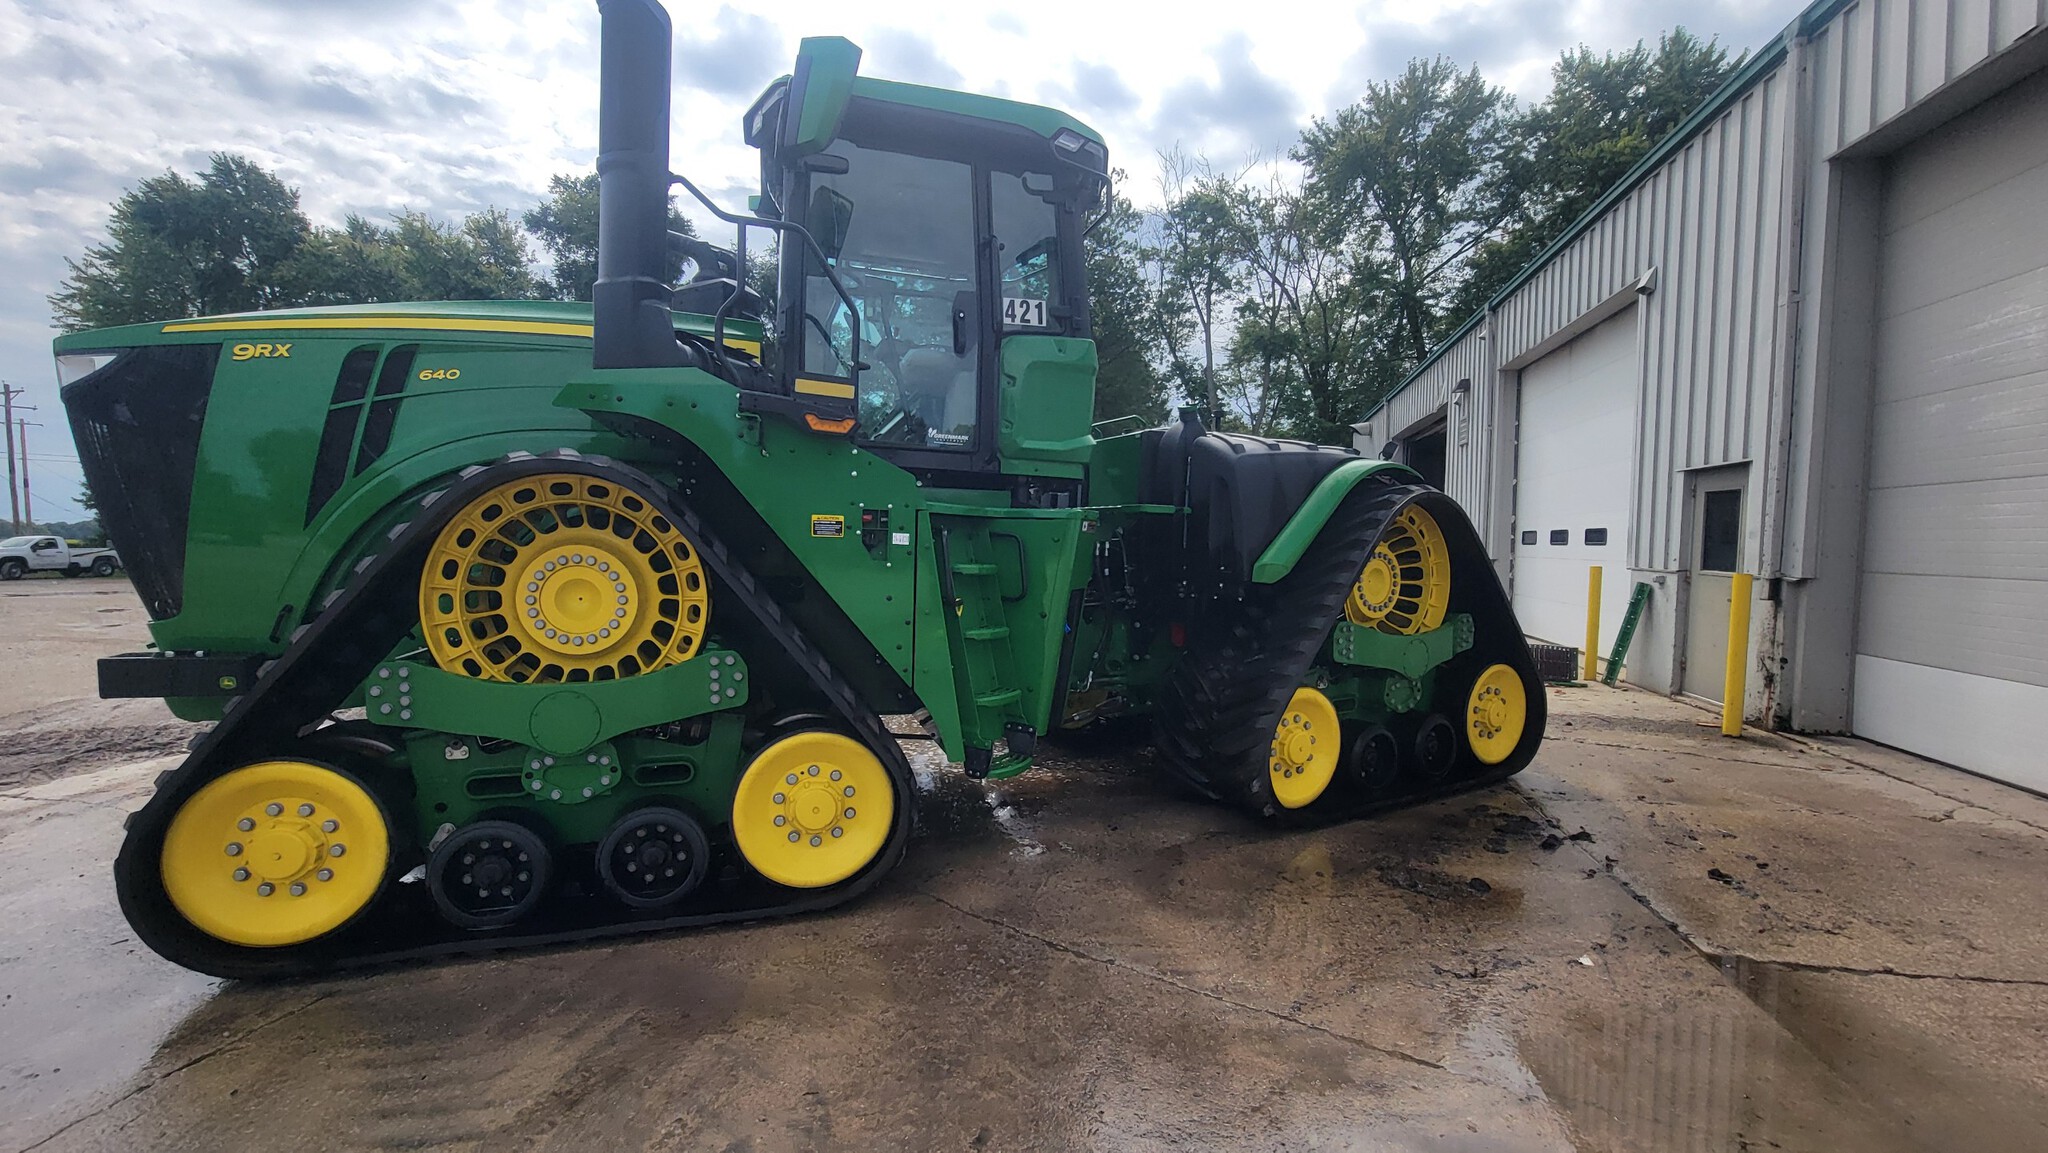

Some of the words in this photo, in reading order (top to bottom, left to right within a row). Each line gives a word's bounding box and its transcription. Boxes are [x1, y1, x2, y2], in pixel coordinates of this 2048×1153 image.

[1005, 299, 1043, 325] 421
[232, 343, 293, 360] 9RX
[419, 369, 460, 380] 640
[933, 433, 969, 441] GREENMARK
